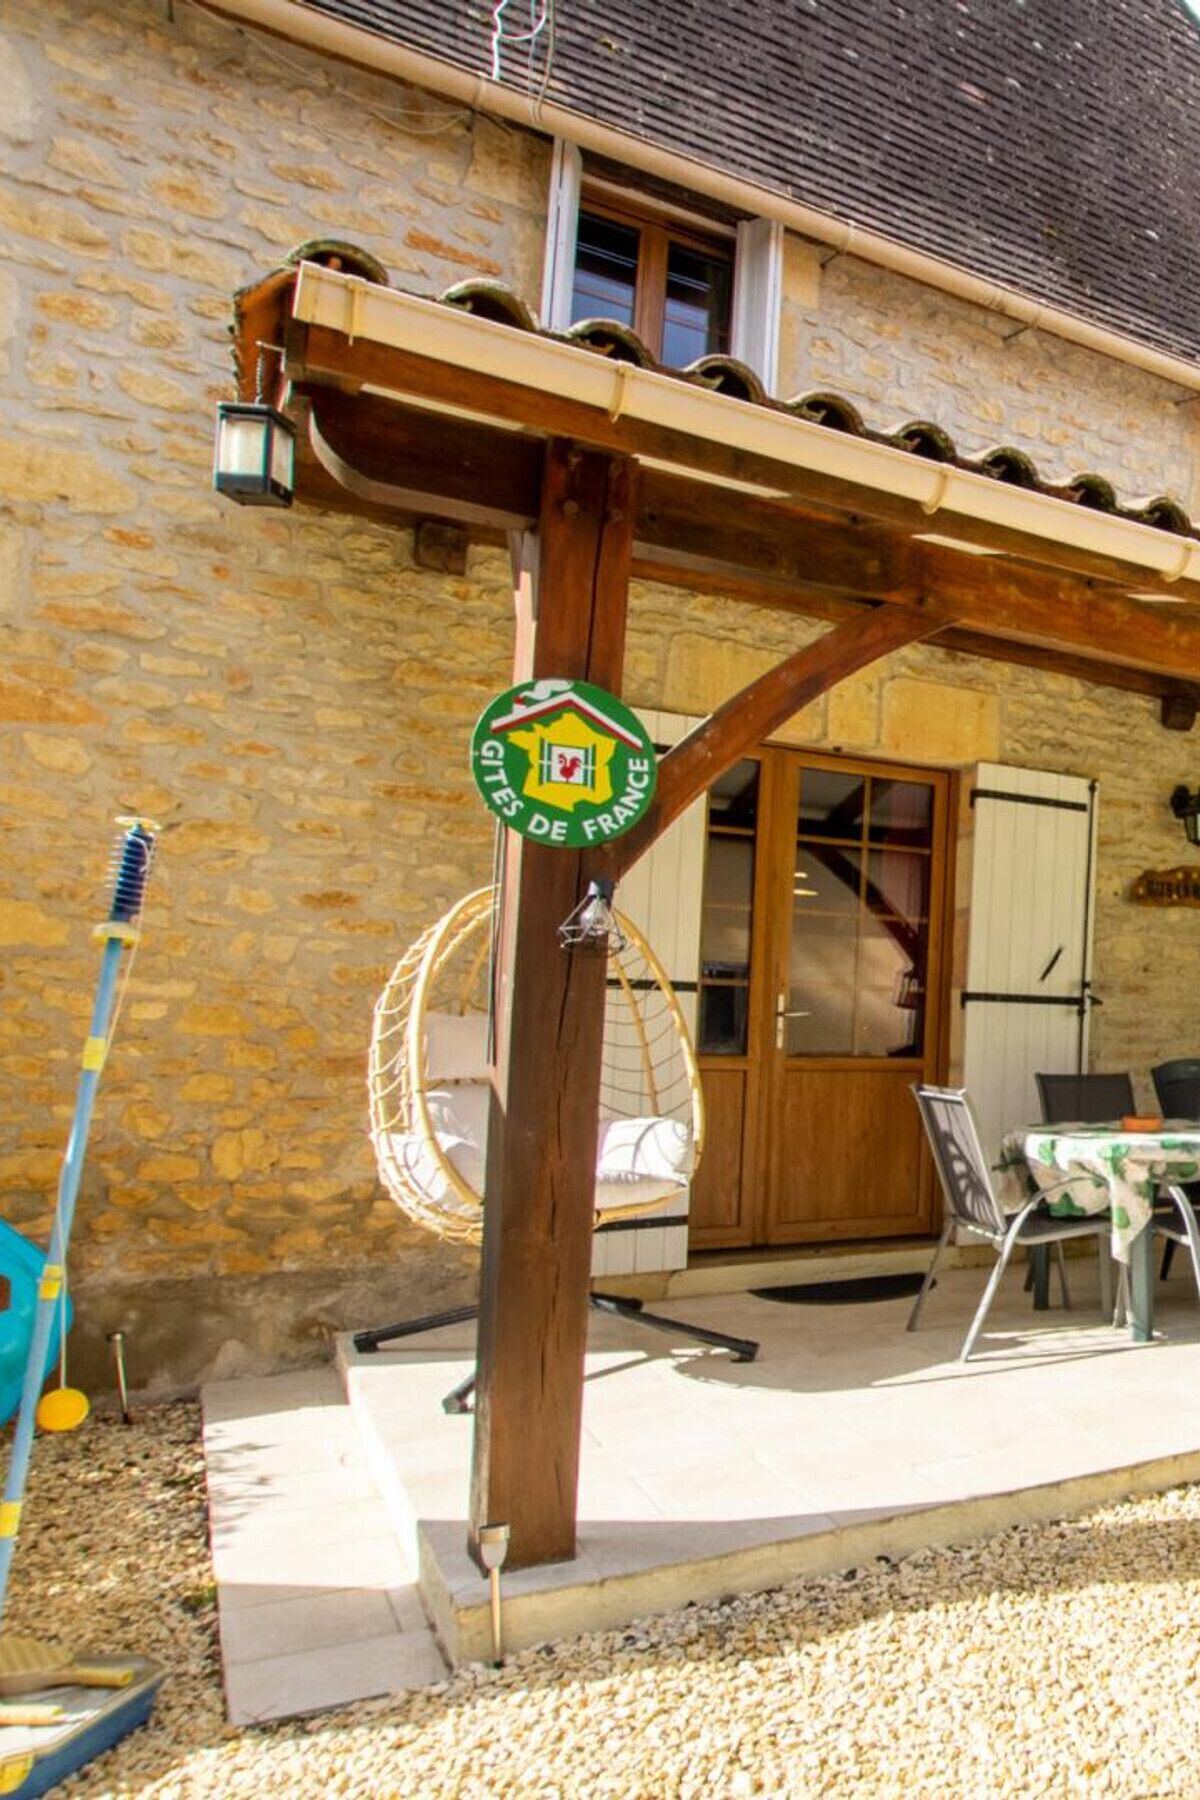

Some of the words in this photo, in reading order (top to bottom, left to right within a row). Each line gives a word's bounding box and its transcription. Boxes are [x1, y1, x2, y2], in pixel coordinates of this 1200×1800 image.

[480, 739, 525, 817] GITES
[527, 813, 568, 841] DE
[581, 757, 649, 840] FRANCE
